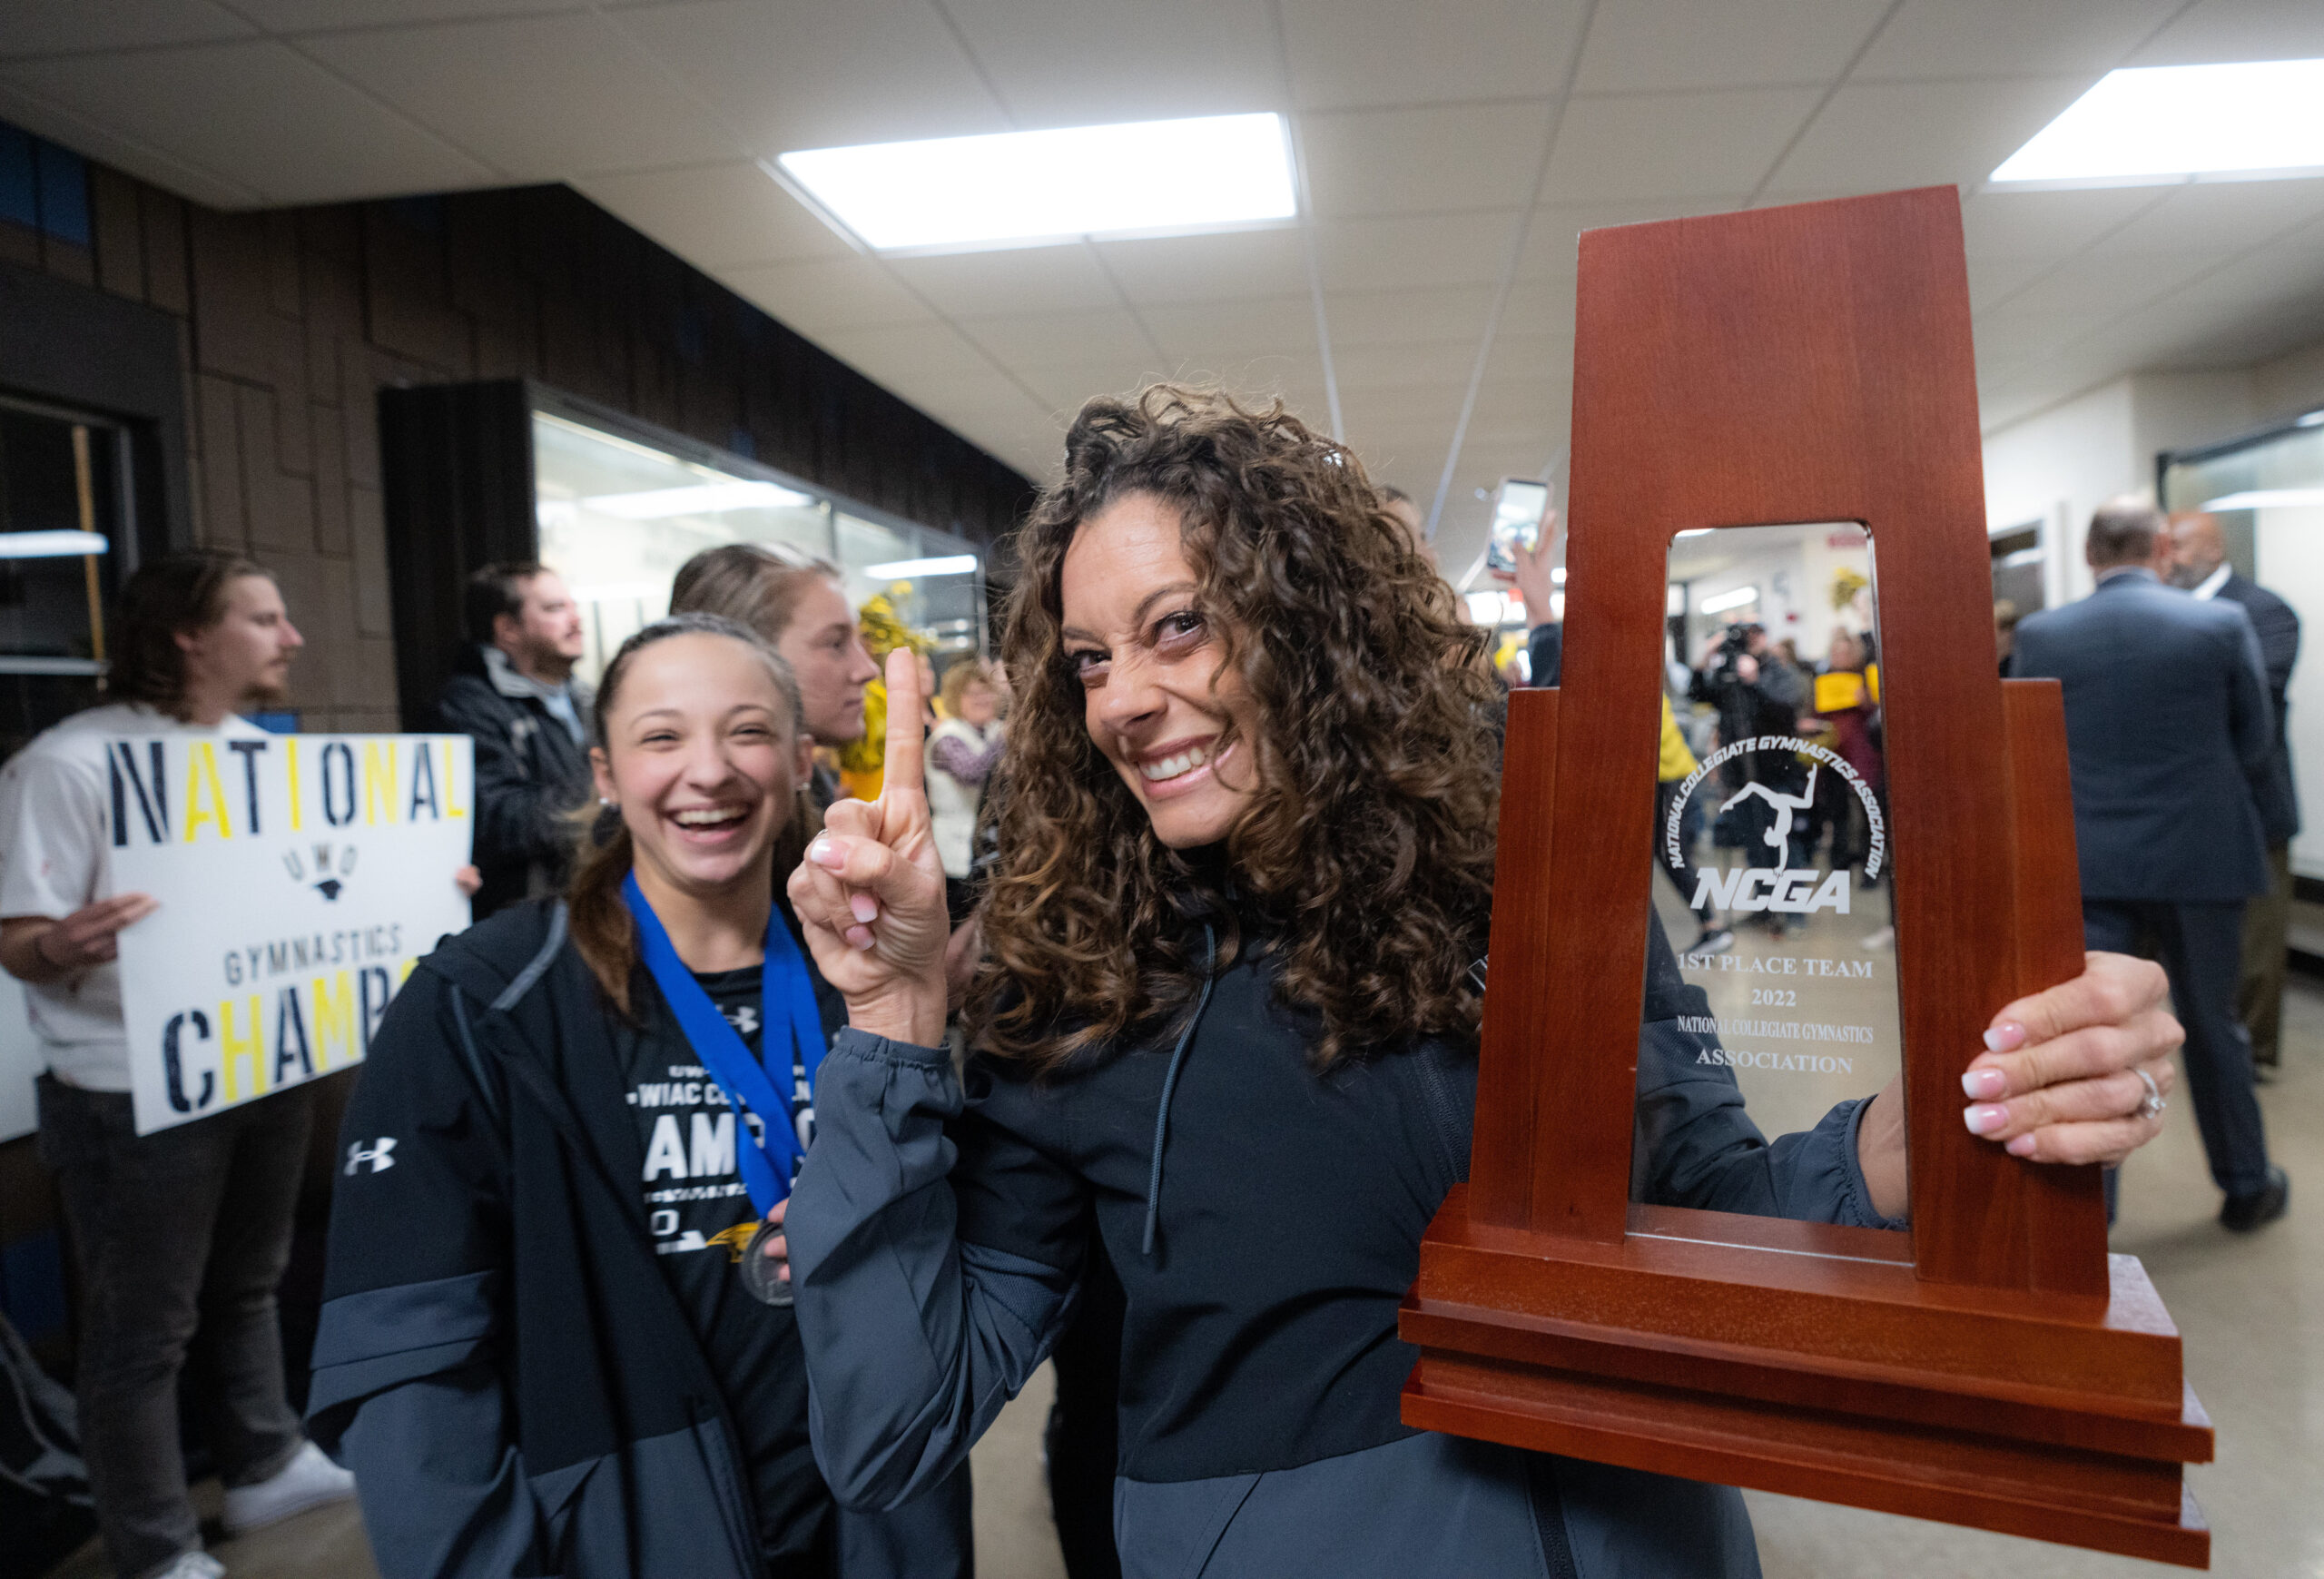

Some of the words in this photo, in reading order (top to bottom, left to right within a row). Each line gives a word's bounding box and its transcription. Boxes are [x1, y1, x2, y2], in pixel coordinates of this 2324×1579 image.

[106, 737, 466, 847] NATIONAL
[1667, 794, 1688, 869] NATIONAL
[1680, 736, 1757, 797] COLLEGIATE
[1758, 735, 1859, 781] GYMNASTICS
[1849, 779, 1886, 880] ASSOCIATION
[282, 844, 358, 881] UWO
[1690, 866, 1850, 914] NCGA
[224, 923, 402, 986] GYMNASTICS
[1678, 953, 1715, 971] 1ST
[1721, 955, 1797, 975] PLACE
[1804, 958, 1874, 979] TEAM
[1751, 988, 1797, 1007] 2022
[1678, 1015, 1730, 1035] NATIONAL
[1732, 1018, 1800, 1040] COLLEGIATE
[1802, 1023, 1874, 1044] GYMNASTICS
[1695, 1048, 1853, 1074] ASSOCIATION
[637, 1082, 703, 1107] WIAC
